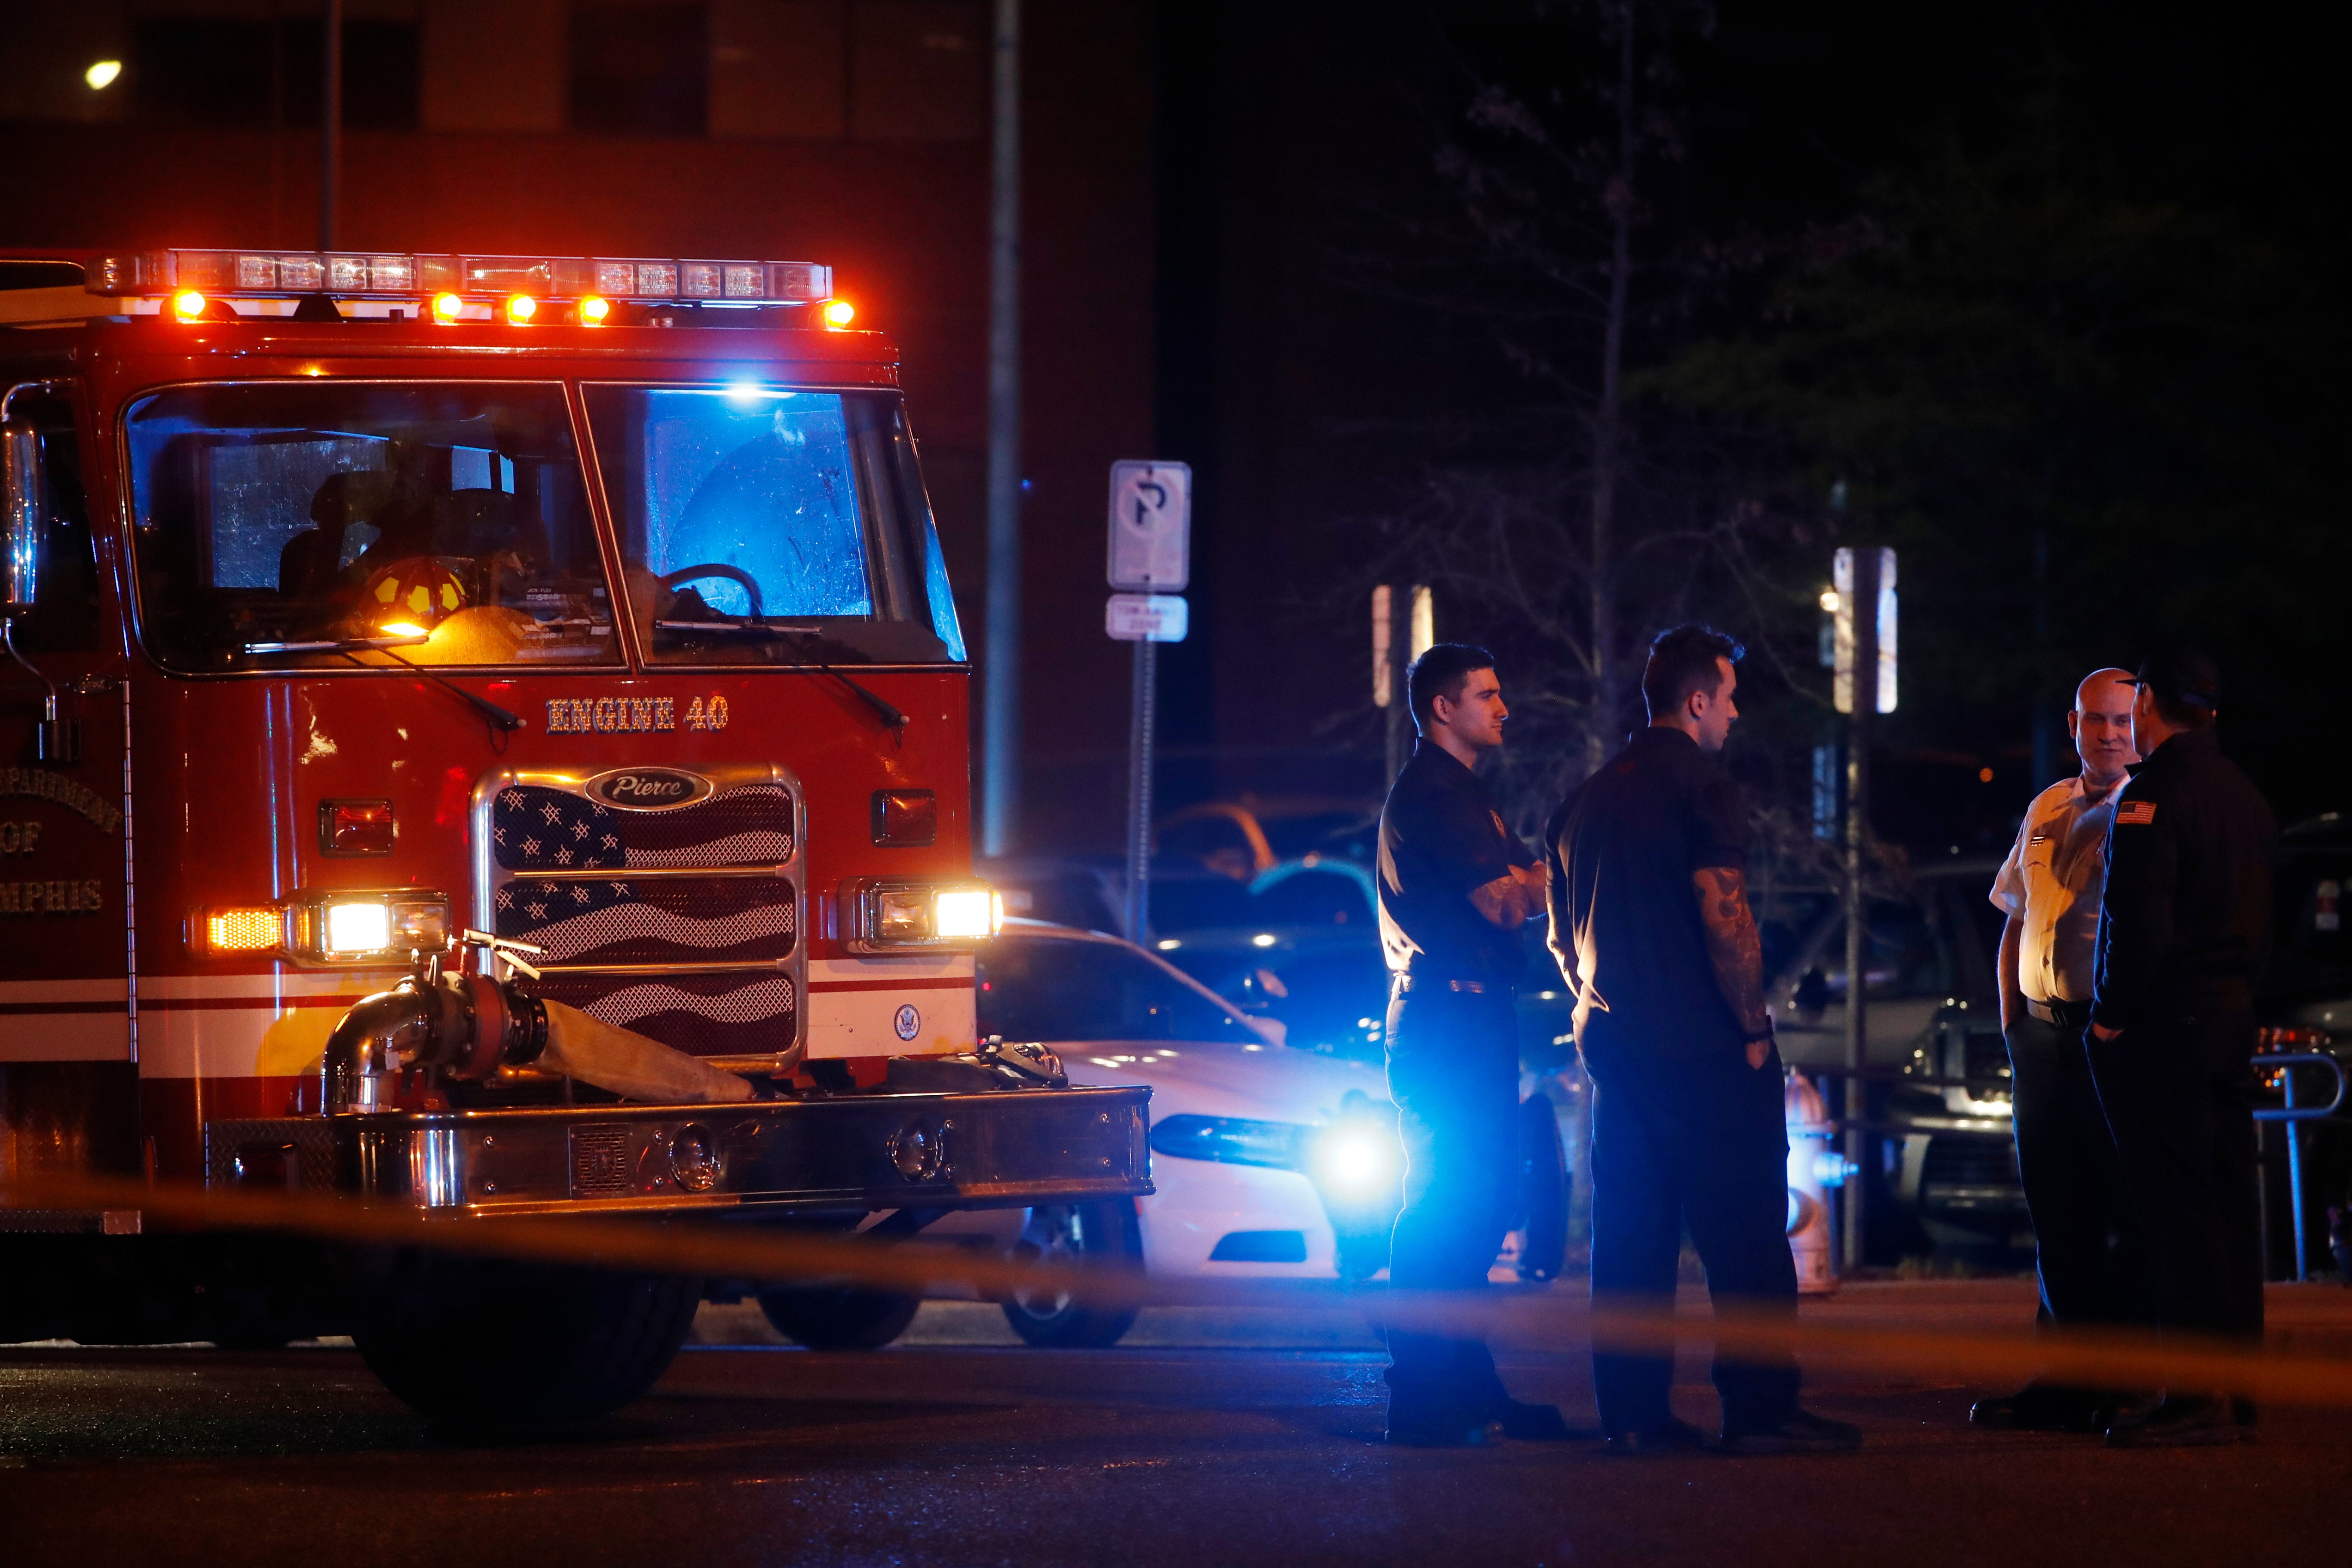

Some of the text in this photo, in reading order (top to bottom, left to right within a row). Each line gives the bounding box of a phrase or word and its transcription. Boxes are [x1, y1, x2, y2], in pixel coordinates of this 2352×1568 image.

[547, 695, 729, 732] ENGINE 40
[612, 775, 682, 799] Pierce
[0, 820, 42, 853] OF
